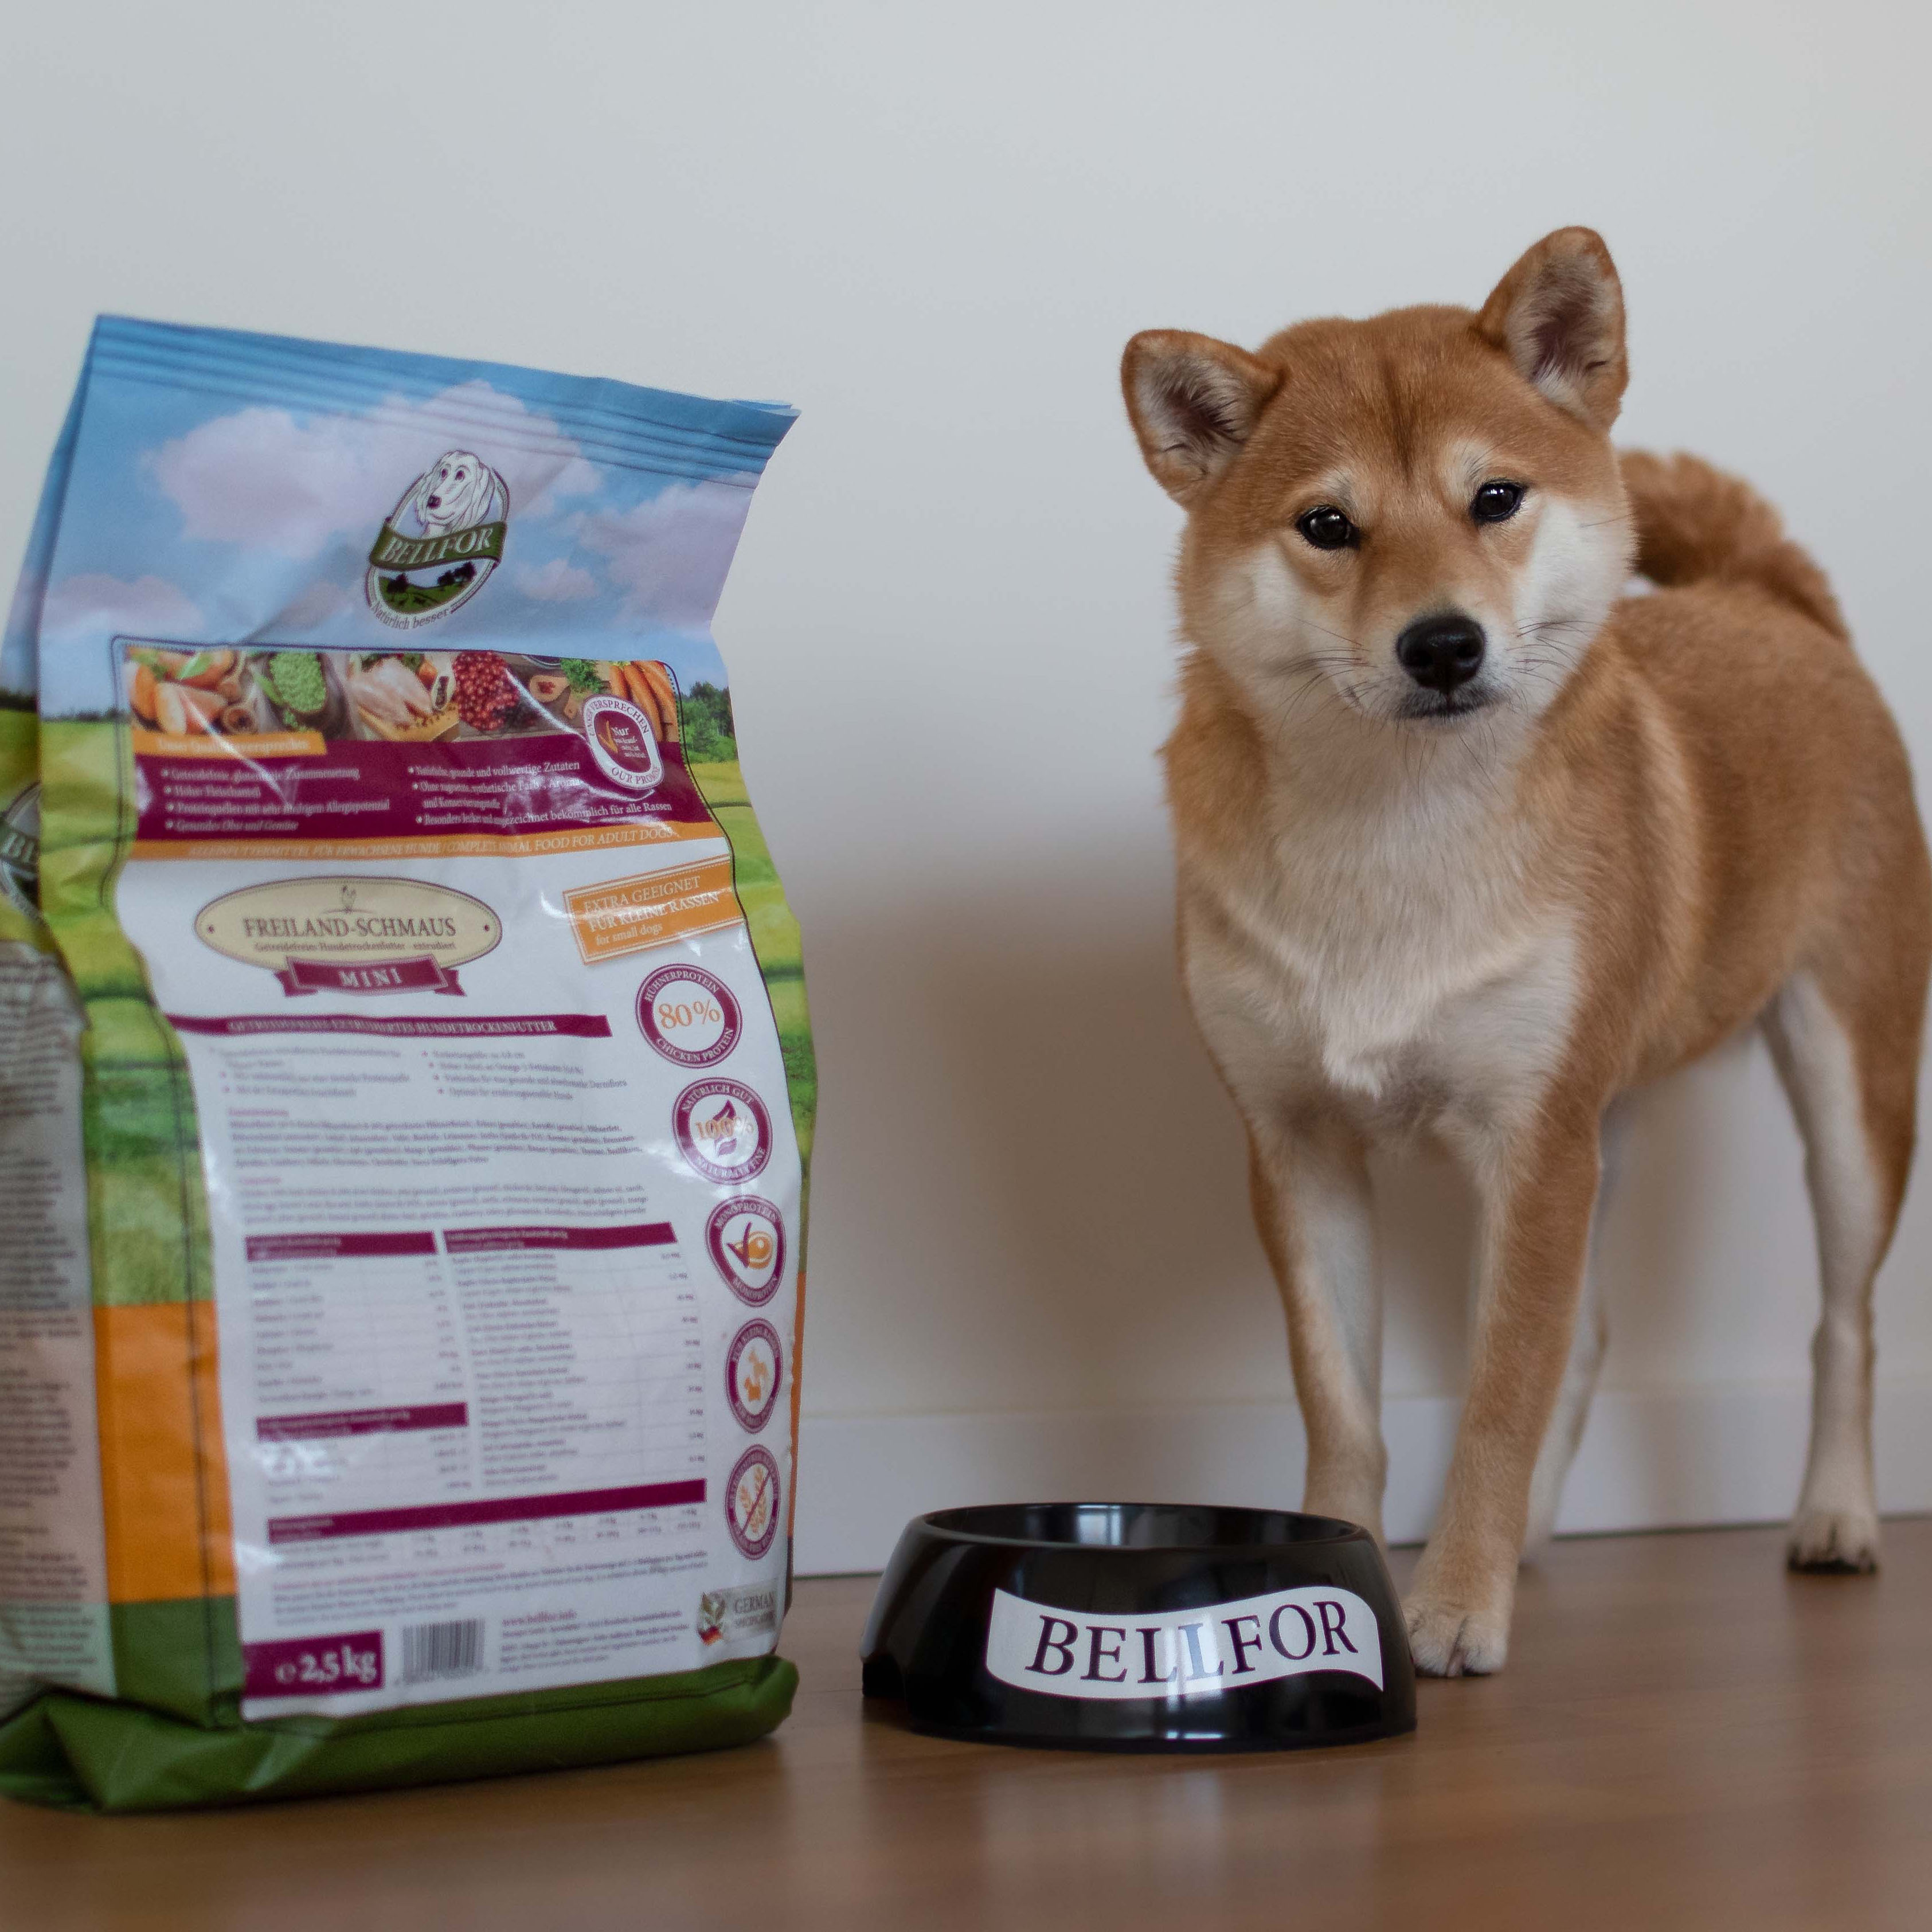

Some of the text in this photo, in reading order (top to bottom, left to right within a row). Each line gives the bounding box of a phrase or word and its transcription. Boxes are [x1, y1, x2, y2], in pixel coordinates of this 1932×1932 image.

[413, 608, 450, 628] besser
[590, 699, 650, 734] VERSPRECHEN
[611, 726, 629, 736] Nur
[476, 766, 491, 776] und
[492, 764, 541, 776] vollwertige
[544, 761, 580, 772] Zutaten
[612, 766, 633, 784] OUR
[610, 805, 624, 815] für
[626, 803, 642, 813] alle
[644, 803, 672, 812] Rassen
[535, 837, 570, 850] FOOD
[573, 834, 595, 847] FOR
[597, 830, 637, 844] ADULT
[639, 827, 673, 840] DOGS
[585, 875, 701, 913] EXTRA GEEIGNET
[670, 890, 720, 913] RASSEN
[242, 916, 457, 938] FREILAND-SCHMAUS
[596, 922, 663, 946] for small dogs
[339, 967, 401, 988] MINI
[659, 999, 721, 1029] 80%
[702, 1027, 734, 1061] PROTEIN
[1024, 1599, 1358, 1684] BELLFOR
